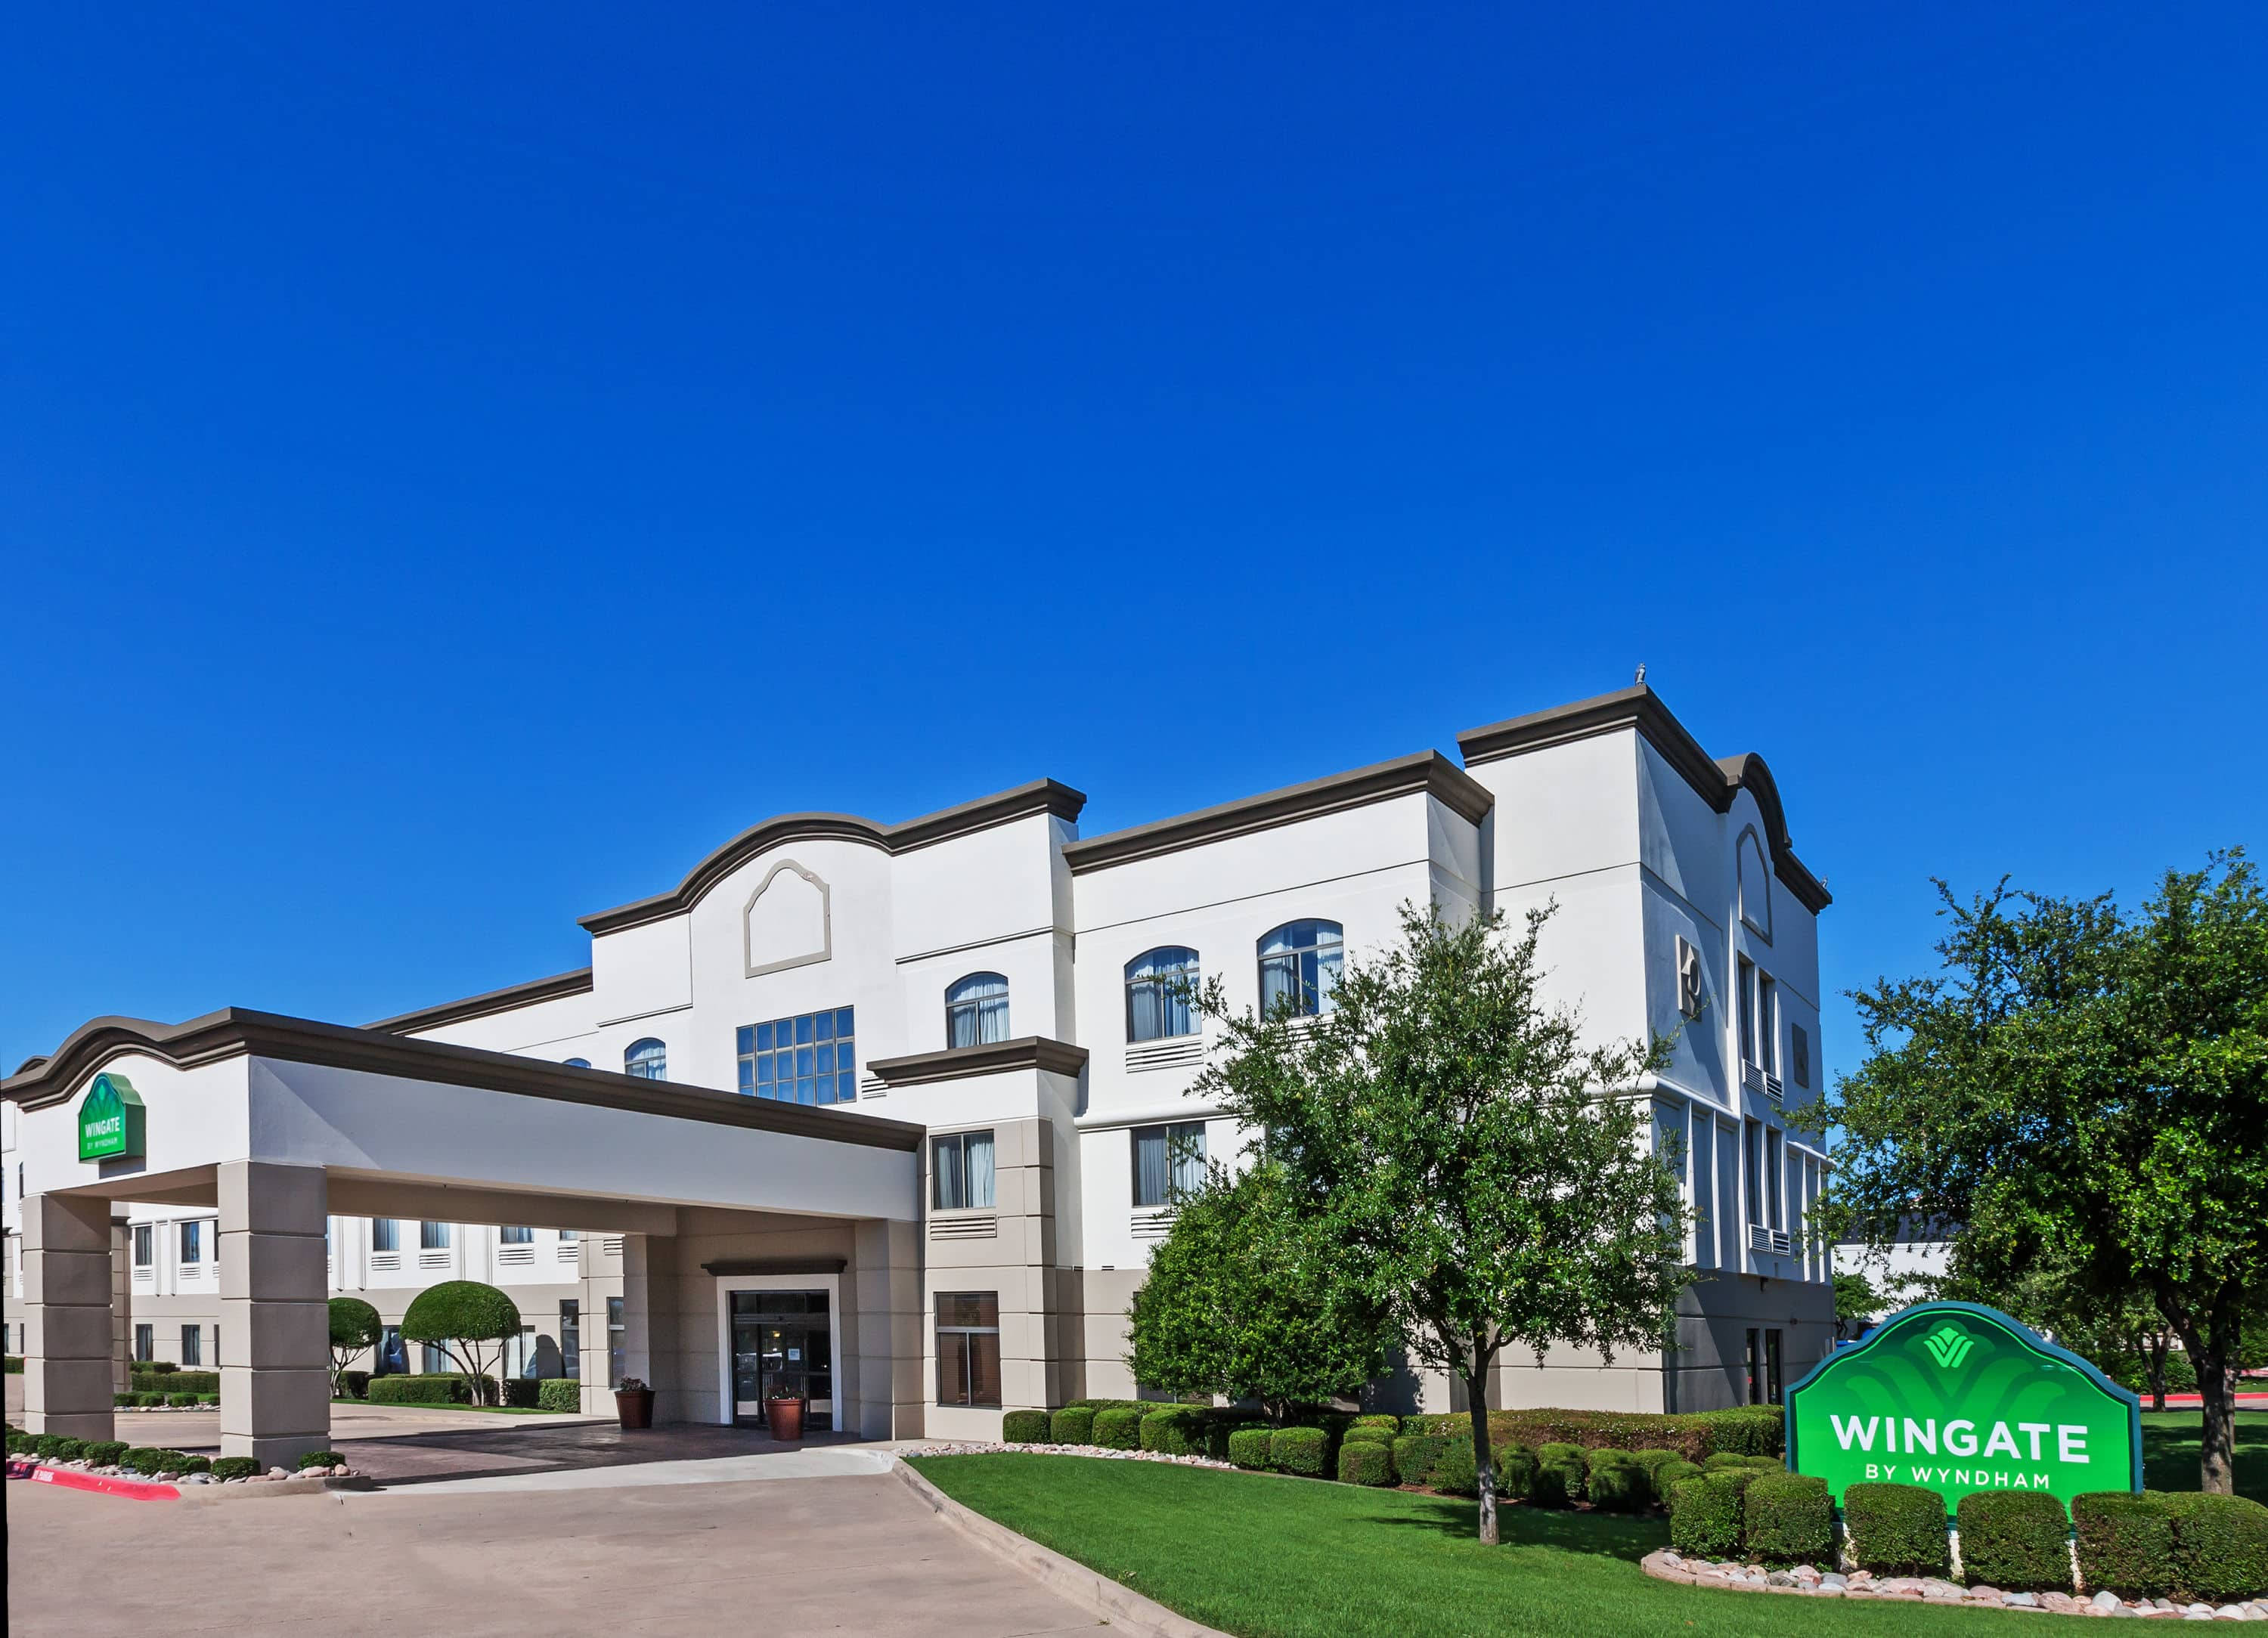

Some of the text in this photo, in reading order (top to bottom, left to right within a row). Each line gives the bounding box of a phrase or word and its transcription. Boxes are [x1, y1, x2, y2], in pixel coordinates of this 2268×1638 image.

[85, 1116, 120, 1138] WINGATE
[1830, 1414, 2090, 1463] WINGATE
[1865, 1463, 2050, 1489] BY WYNDHAM
